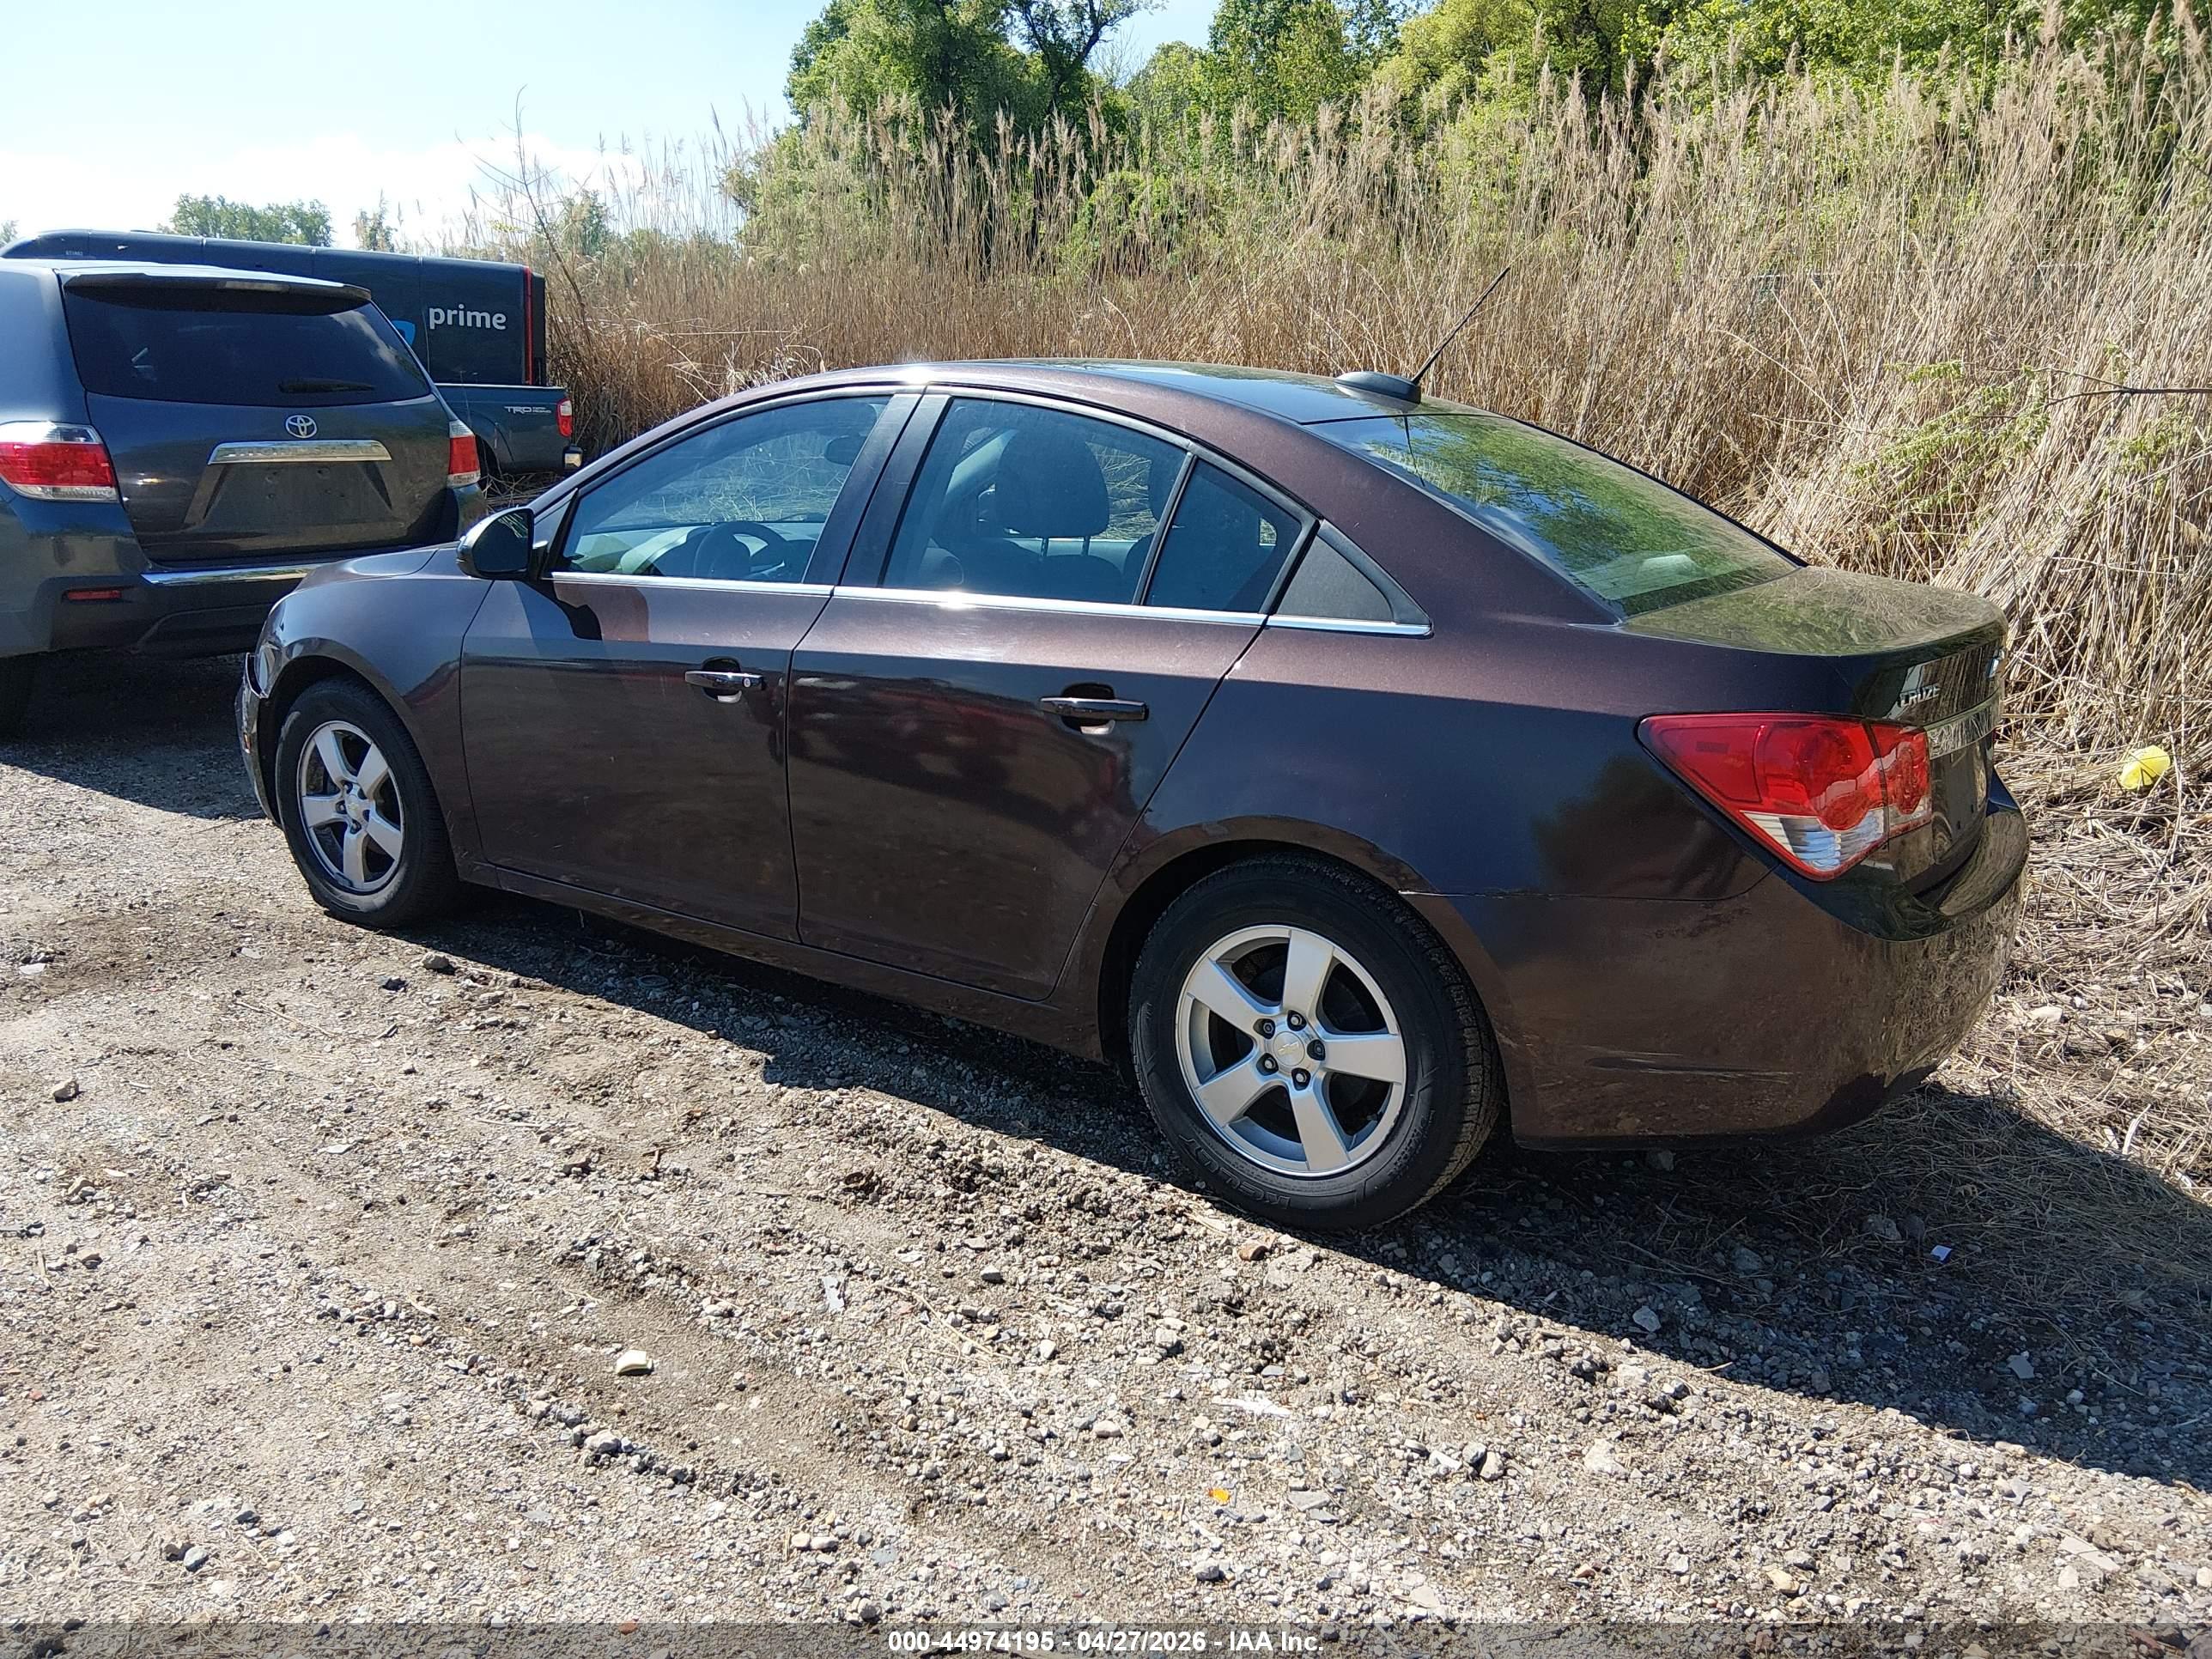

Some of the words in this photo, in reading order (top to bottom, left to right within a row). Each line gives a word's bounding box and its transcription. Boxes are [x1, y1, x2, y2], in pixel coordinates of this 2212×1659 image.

[429, 304, 507, 330] prime
[1899, 684, 1941, 708] CRUZE
[1178, 1133, 1291, 1209] KELLY
